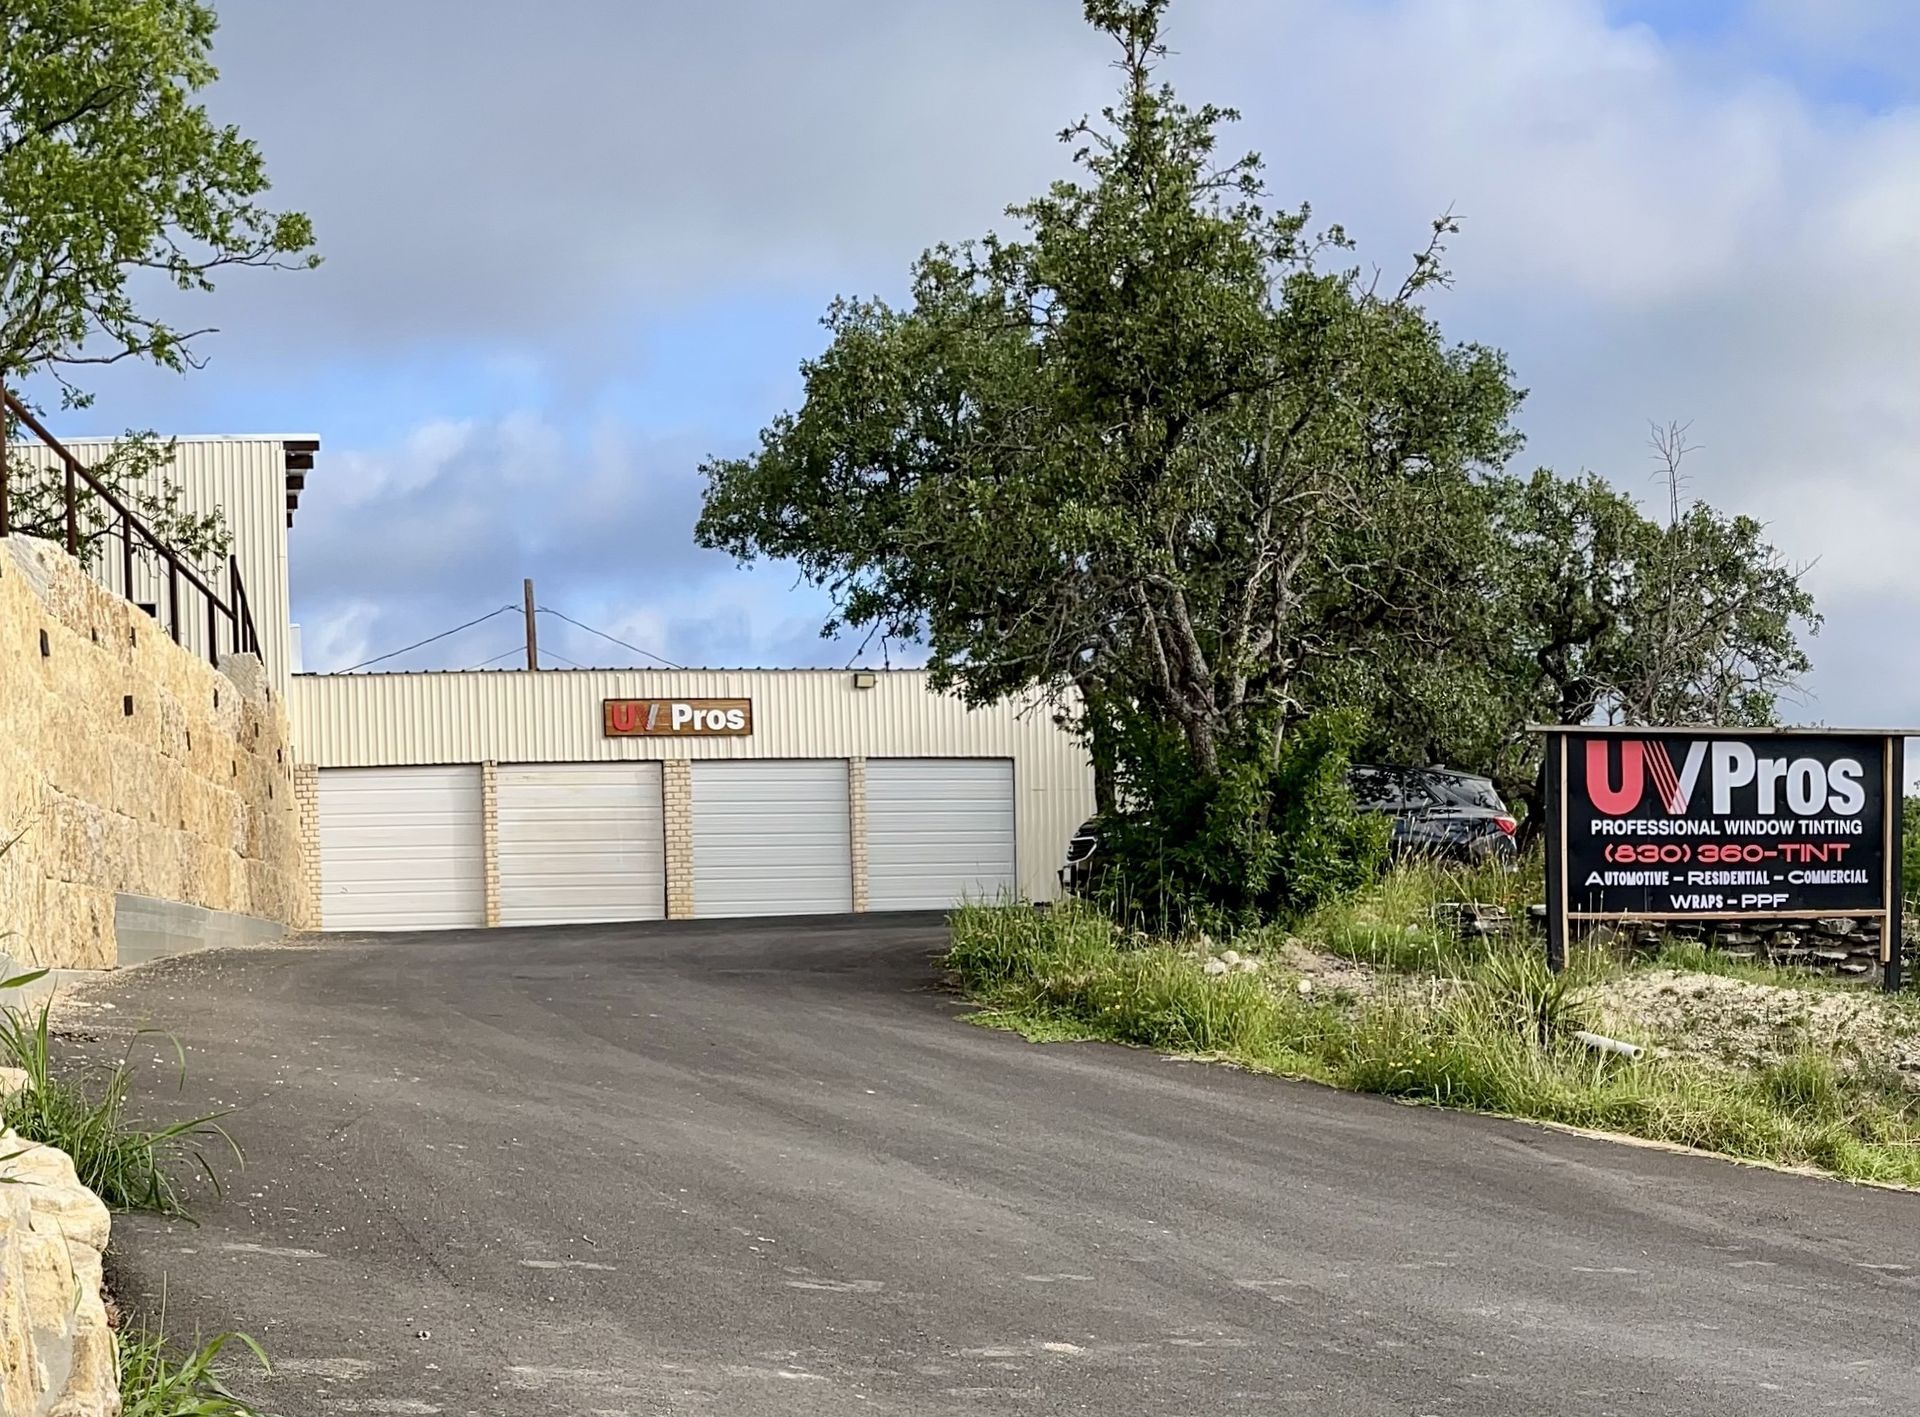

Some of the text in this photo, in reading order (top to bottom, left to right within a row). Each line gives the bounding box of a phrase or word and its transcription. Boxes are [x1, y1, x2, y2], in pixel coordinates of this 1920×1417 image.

[611, 703, 745, 731] UV Pros
[1591, 819, 1862, 836] PROFESSIONAL WINDOW TINTING
[1604, 843, 1850, 863] (830) 360-TINT
[1585, 871, 1669, 886] AUTOMOTIVE
[1688, 871, 1770, 886] RESIDENTIAL
[1788, 870, 1868, 884] COMMERCIAL
[1670, 895, 1723, 909] WRAPS
[1741, 894, 1789, 908] PPF
